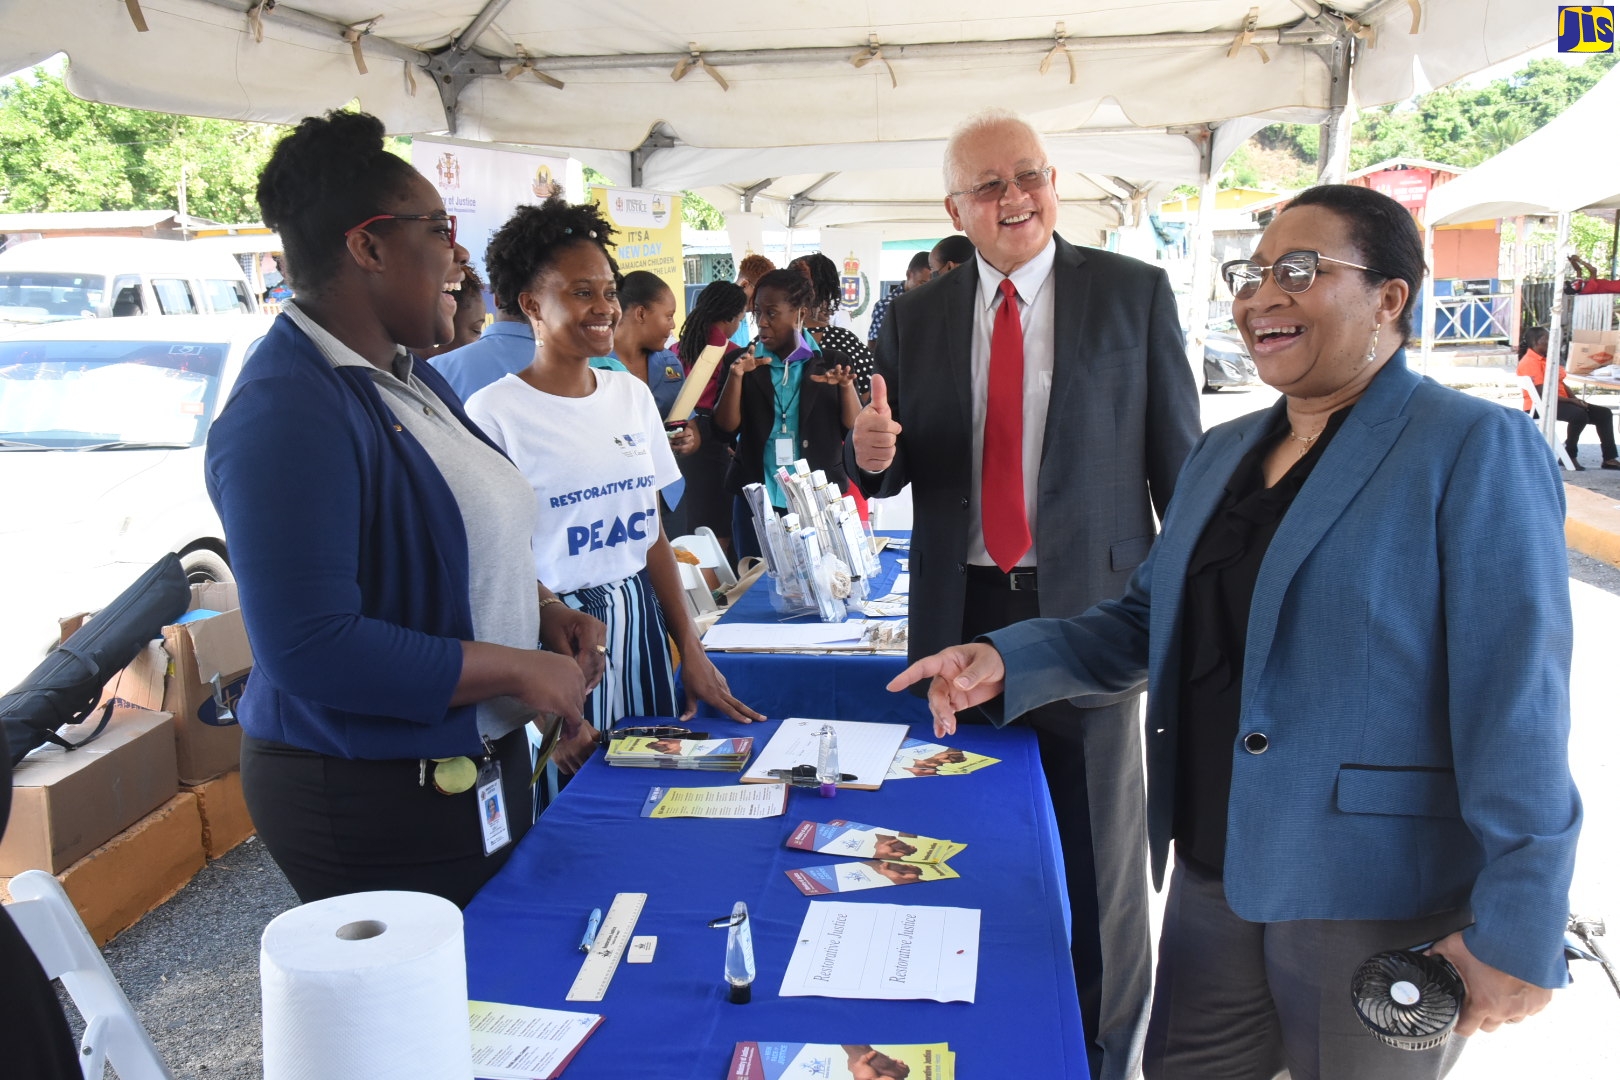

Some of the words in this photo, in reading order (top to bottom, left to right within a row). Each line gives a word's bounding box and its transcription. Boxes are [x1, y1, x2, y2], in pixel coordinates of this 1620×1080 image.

[455, 196, 476, 207] Justice
[626, 202, 648, 213] JUSTICE
[628, 231, 643, 242] IT'S
[644, 230, 650, 241] A
[618, 245, 641, 260] NEW
[643, 242, 663, 257] DAY
[647, 256, 675, 267] CHILDREN
[664, 265, 677, 274] LAW
[549, 479, 634, 508] RESTORATIVE
[567, 508, 656, 556] PEAC
[898, 913, 917, 939] Justice
[813, 940, 841, 982] Restorative
[827, 913, 848, 939] Justice
[889, 940, 912, 984] Restorative
